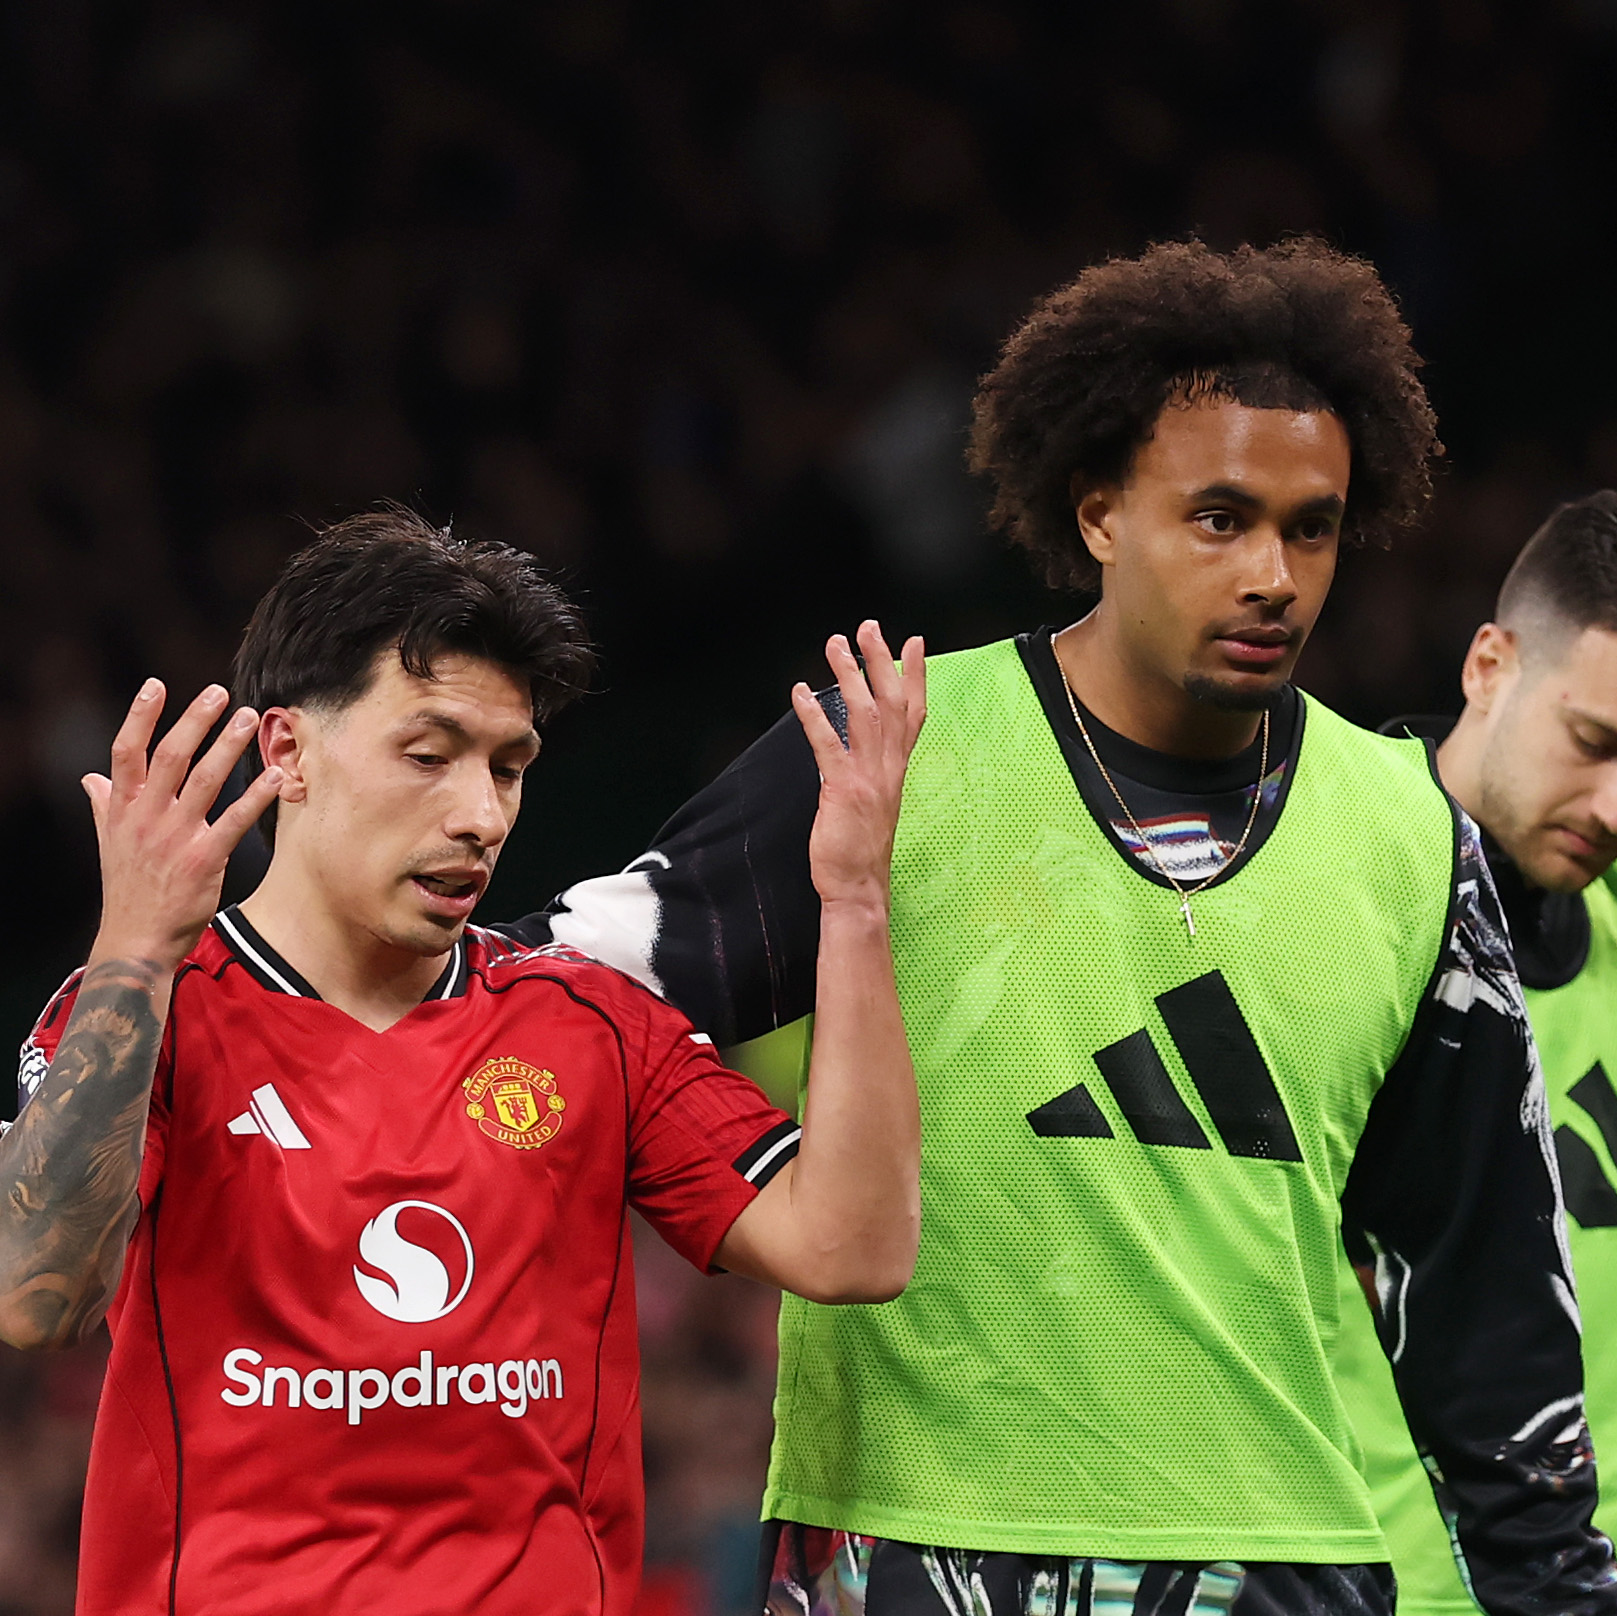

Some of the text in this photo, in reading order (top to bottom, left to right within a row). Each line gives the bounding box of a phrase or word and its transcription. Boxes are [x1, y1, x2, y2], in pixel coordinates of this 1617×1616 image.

[470, 1063, 550, 1097] MANCHESTER
[497, 1125, 552, 1144] UNITED
[220, 1347, 564, 1426] Snapdragon
